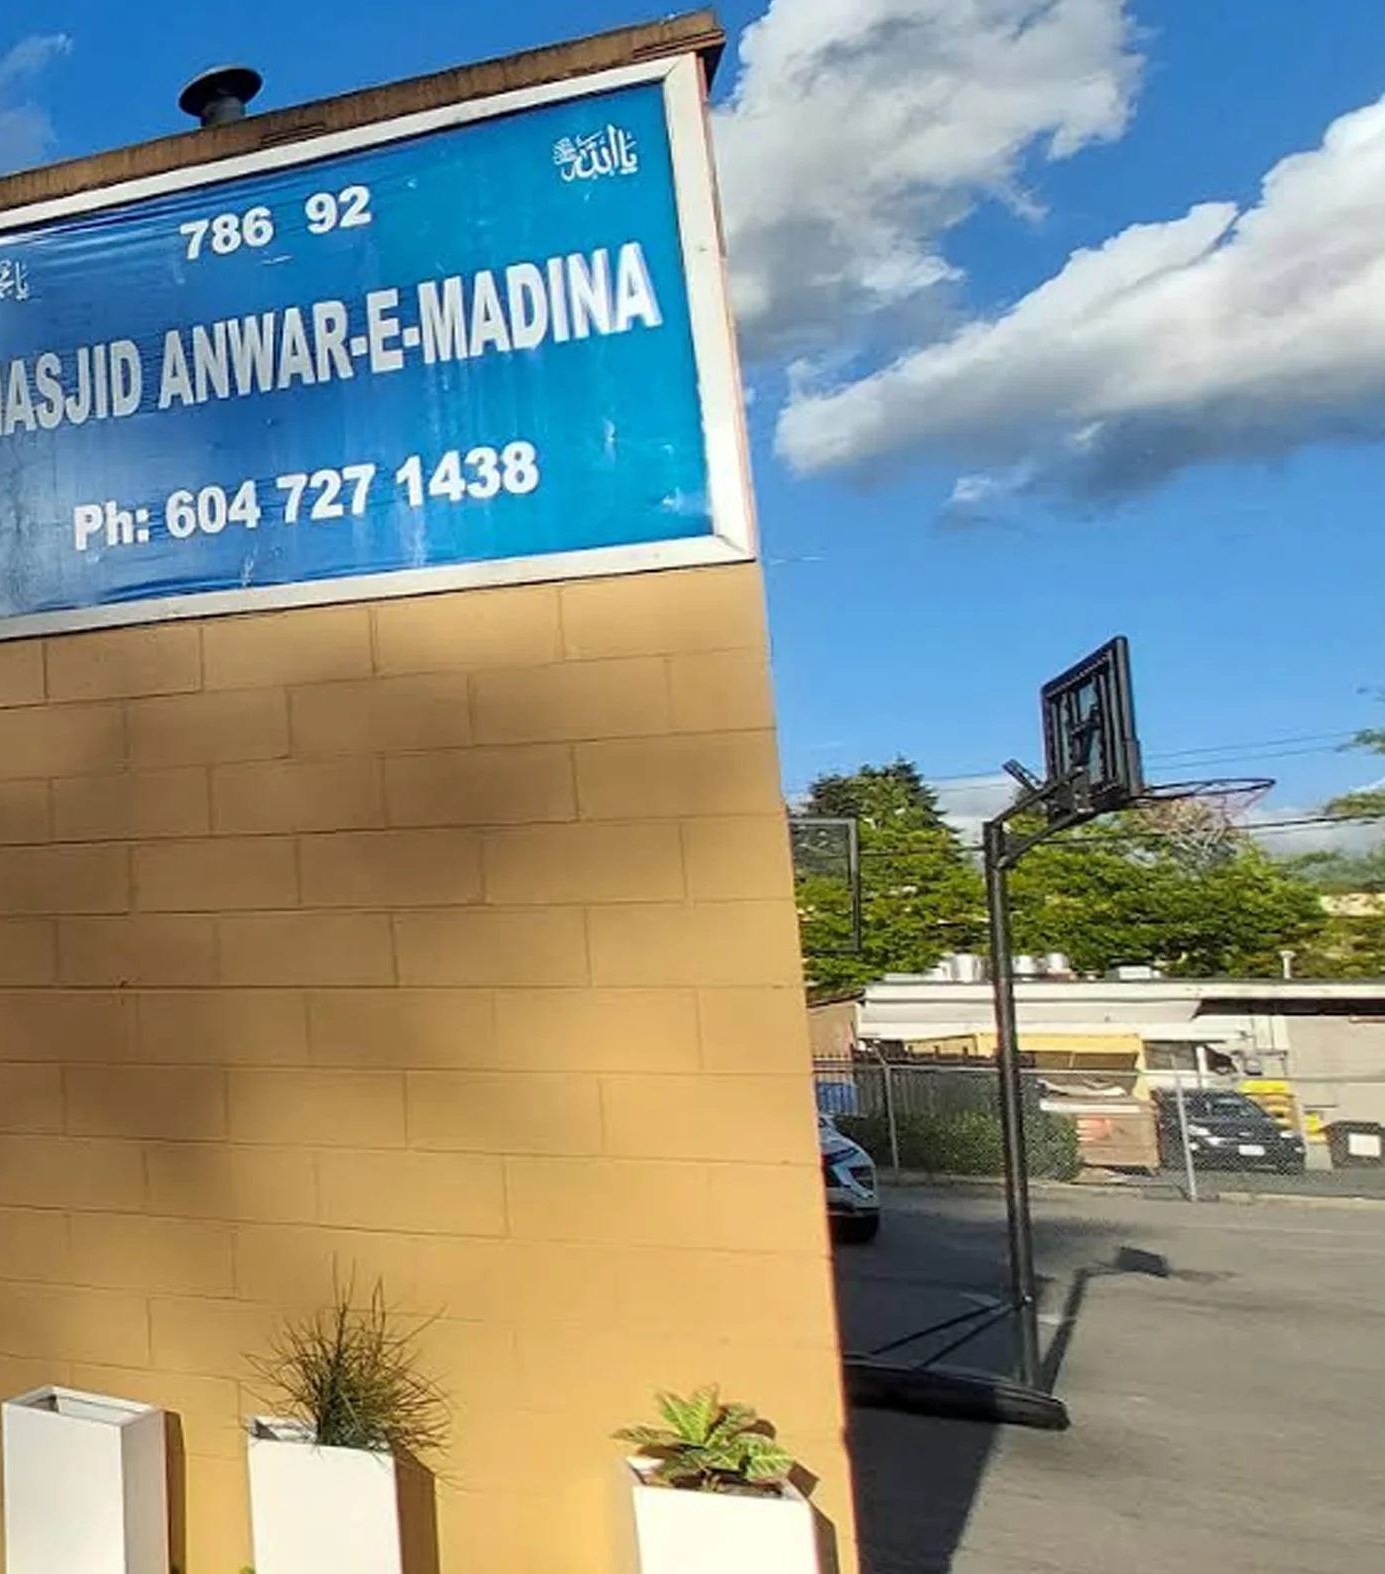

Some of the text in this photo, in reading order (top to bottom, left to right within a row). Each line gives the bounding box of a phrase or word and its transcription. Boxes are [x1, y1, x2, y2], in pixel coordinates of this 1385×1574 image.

[180, 185, 372, 260] 786 92
[158, 241, 663, 410] ANWAR-E-MADINA
[73, 441, 539, 551] Ph: 604 727 1438
